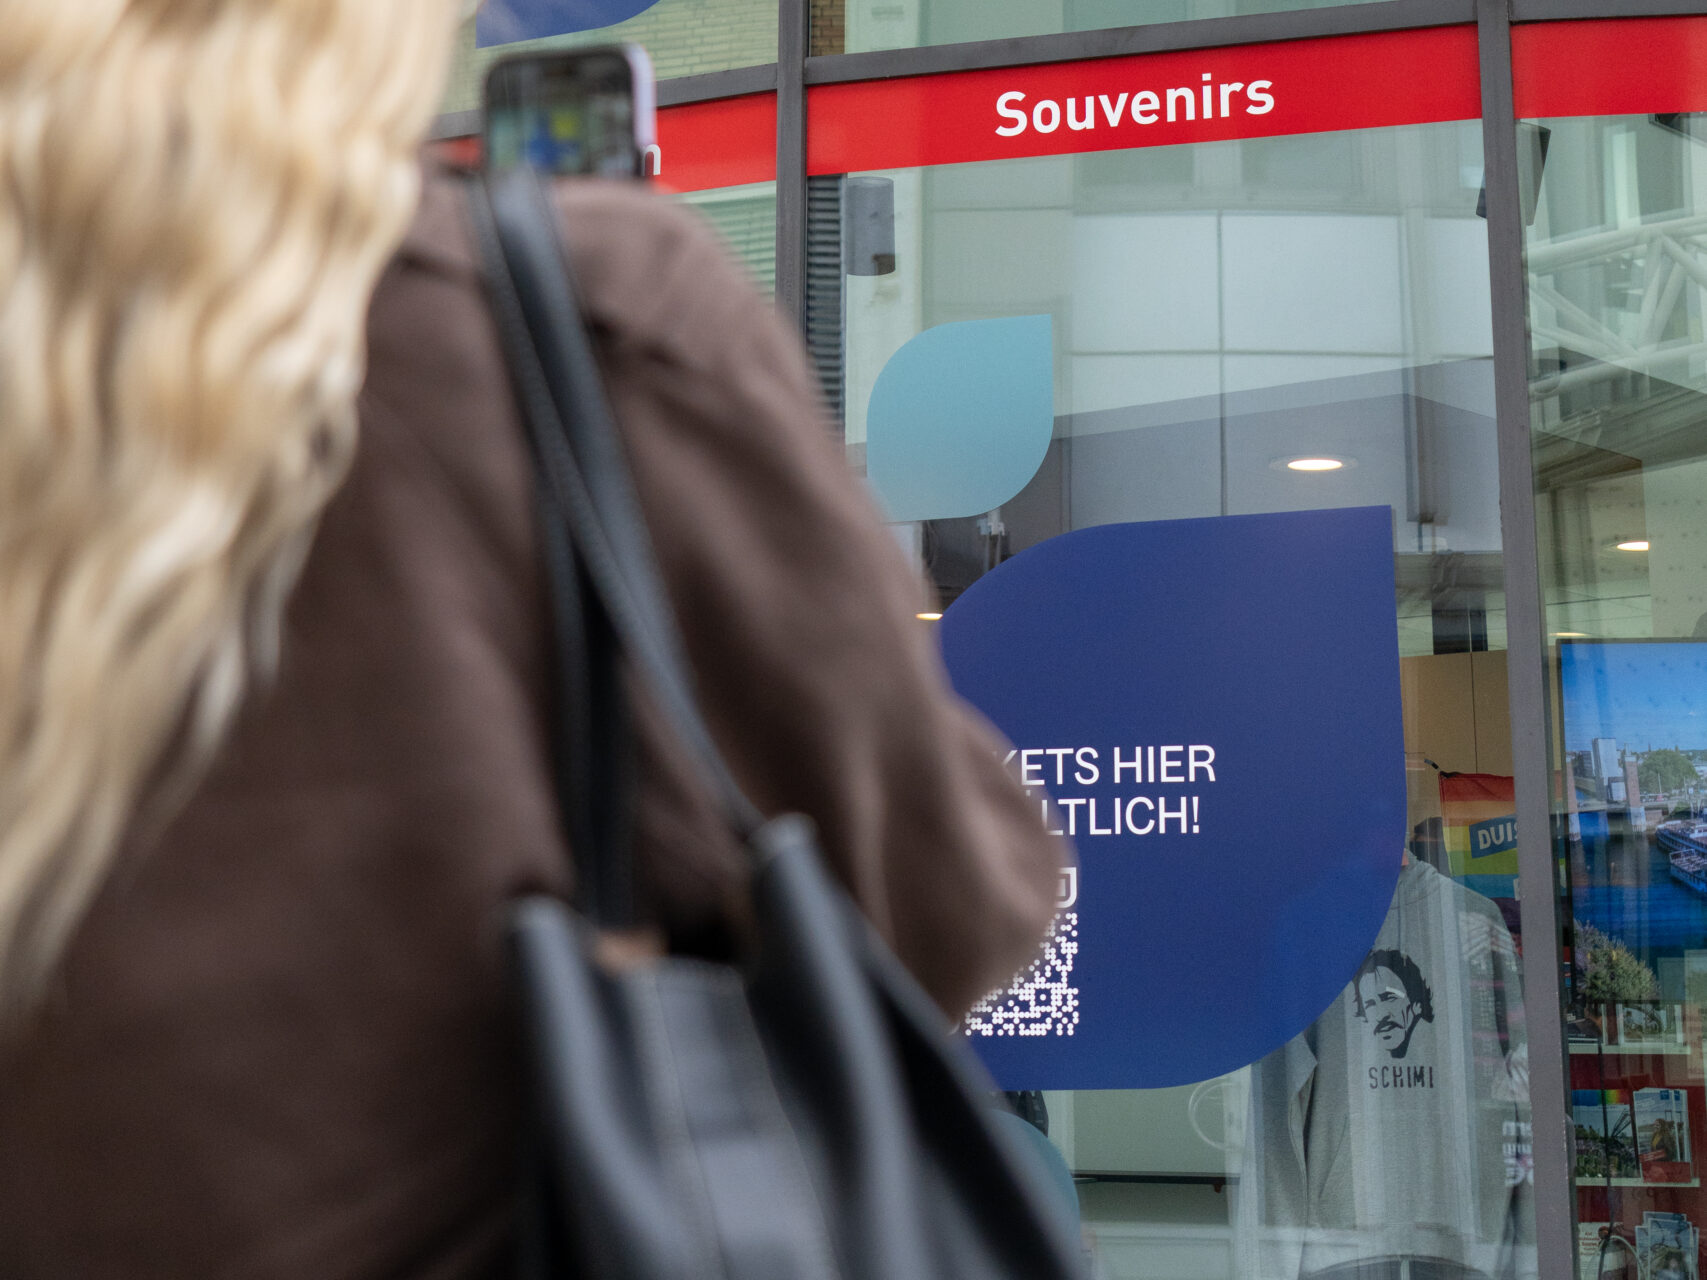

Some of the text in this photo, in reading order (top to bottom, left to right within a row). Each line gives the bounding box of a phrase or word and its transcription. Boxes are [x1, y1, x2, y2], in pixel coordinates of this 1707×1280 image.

[995, 73, 1275, 137] Souvenirs
[1113, 744, 1216, 784] HIER
[1025, 790, 1200, 836] LTLICH!
[1368, 1066, 1435, 1089] SCHIMI
